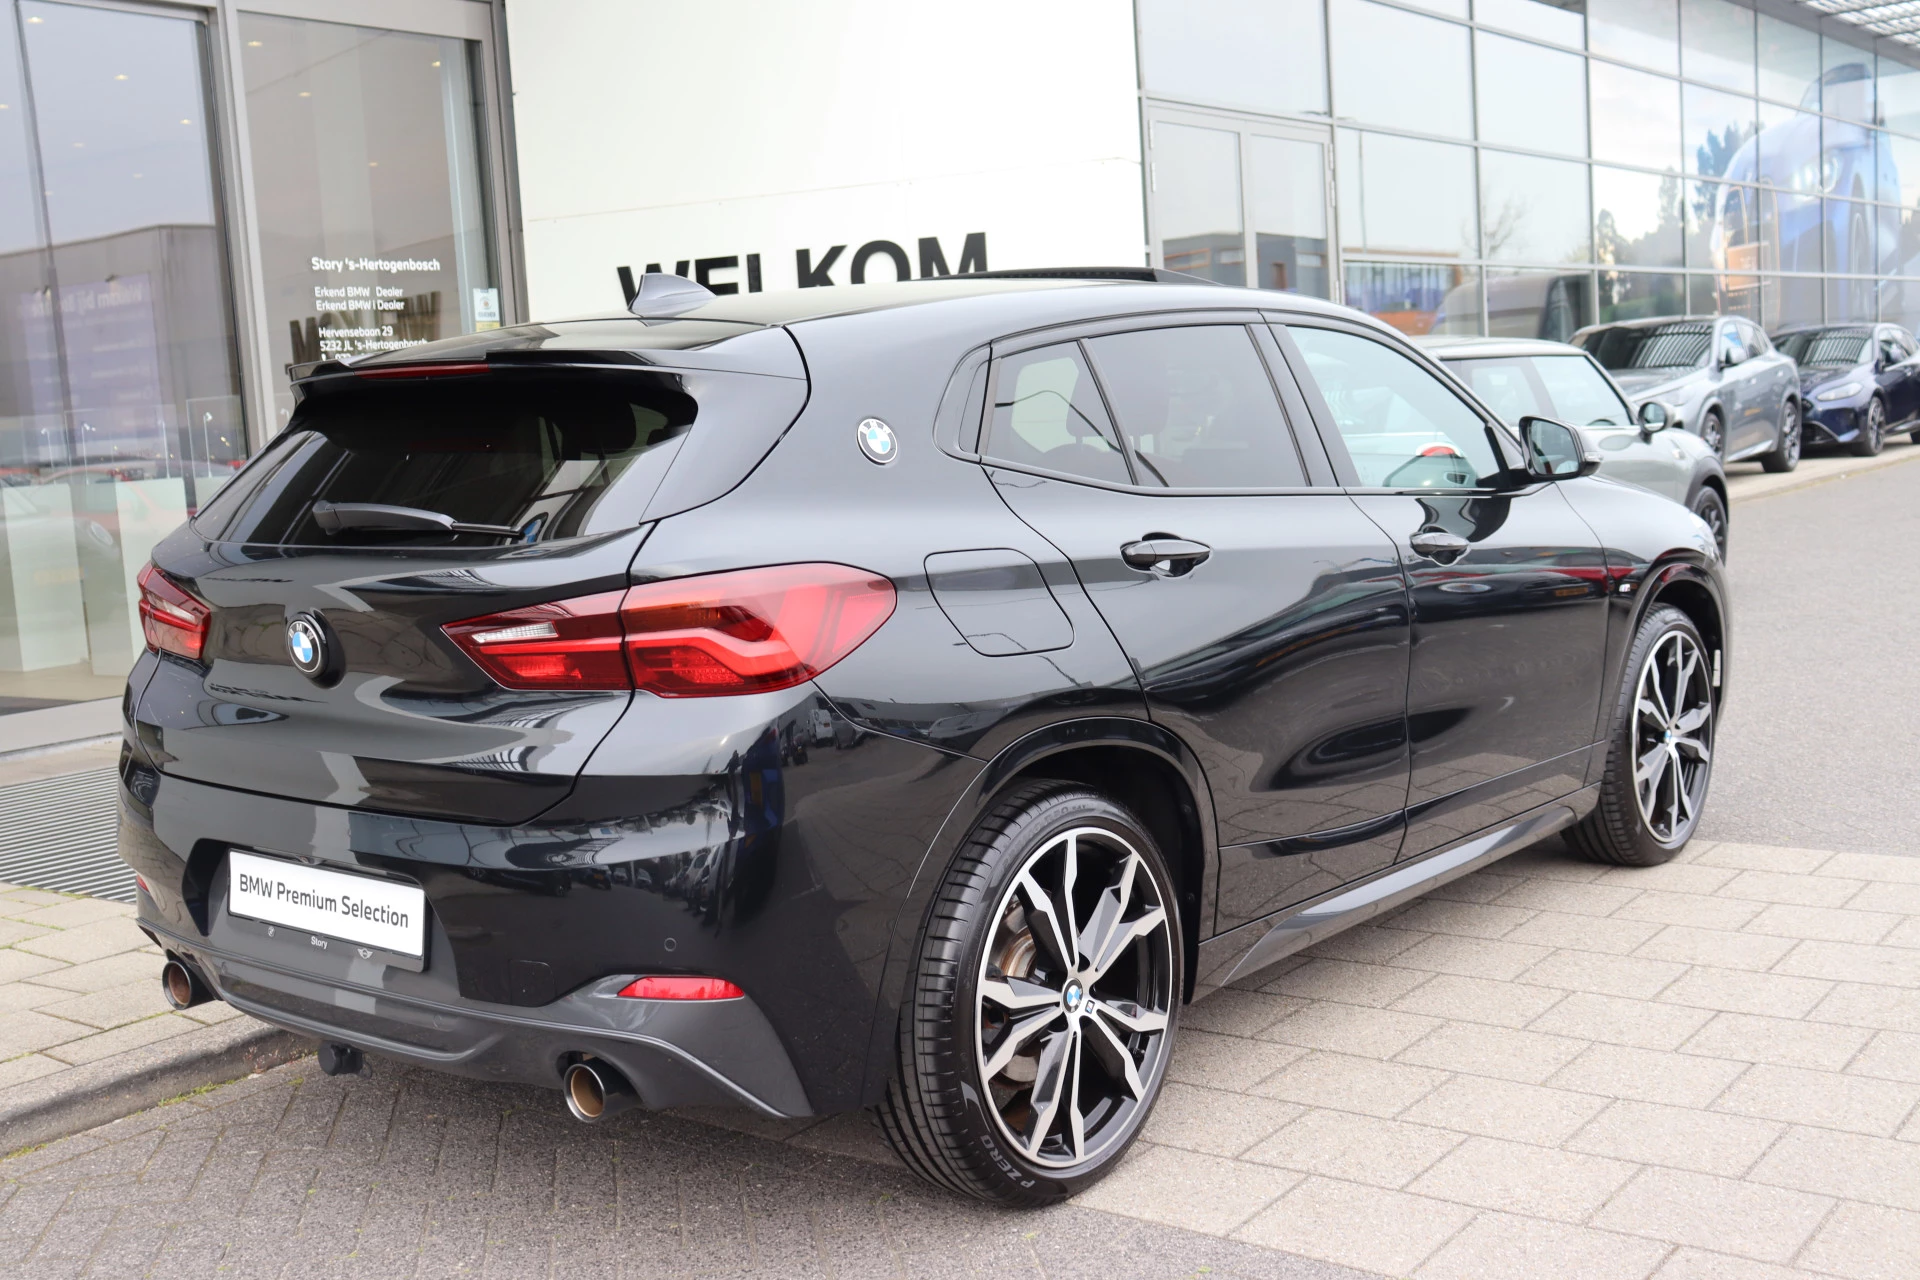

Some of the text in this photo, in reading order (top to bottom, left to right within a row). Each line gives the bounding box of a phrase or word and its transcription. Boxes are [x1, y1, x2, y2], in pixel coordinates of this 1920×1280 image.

[311, 256, 441, 274] Story 's-Hertogenbosch
[314, 286, 404, 298] Erkend BMW Dealer
[316, 299, 347, 311] Erkend
[348, 299, 371, 310] BMW
[377, 299, 405, 310] Dealer
[318, 326, 394, 338] Hervensebaan 29
[320, 340, 342, 352] 5232
[343, 340, 354, 352] JL
[239, 873, 409, 929] BMW Premium Selection
[310, 935, 328, 950] Story
[980, 1134, 1022, 1181] ZERO
